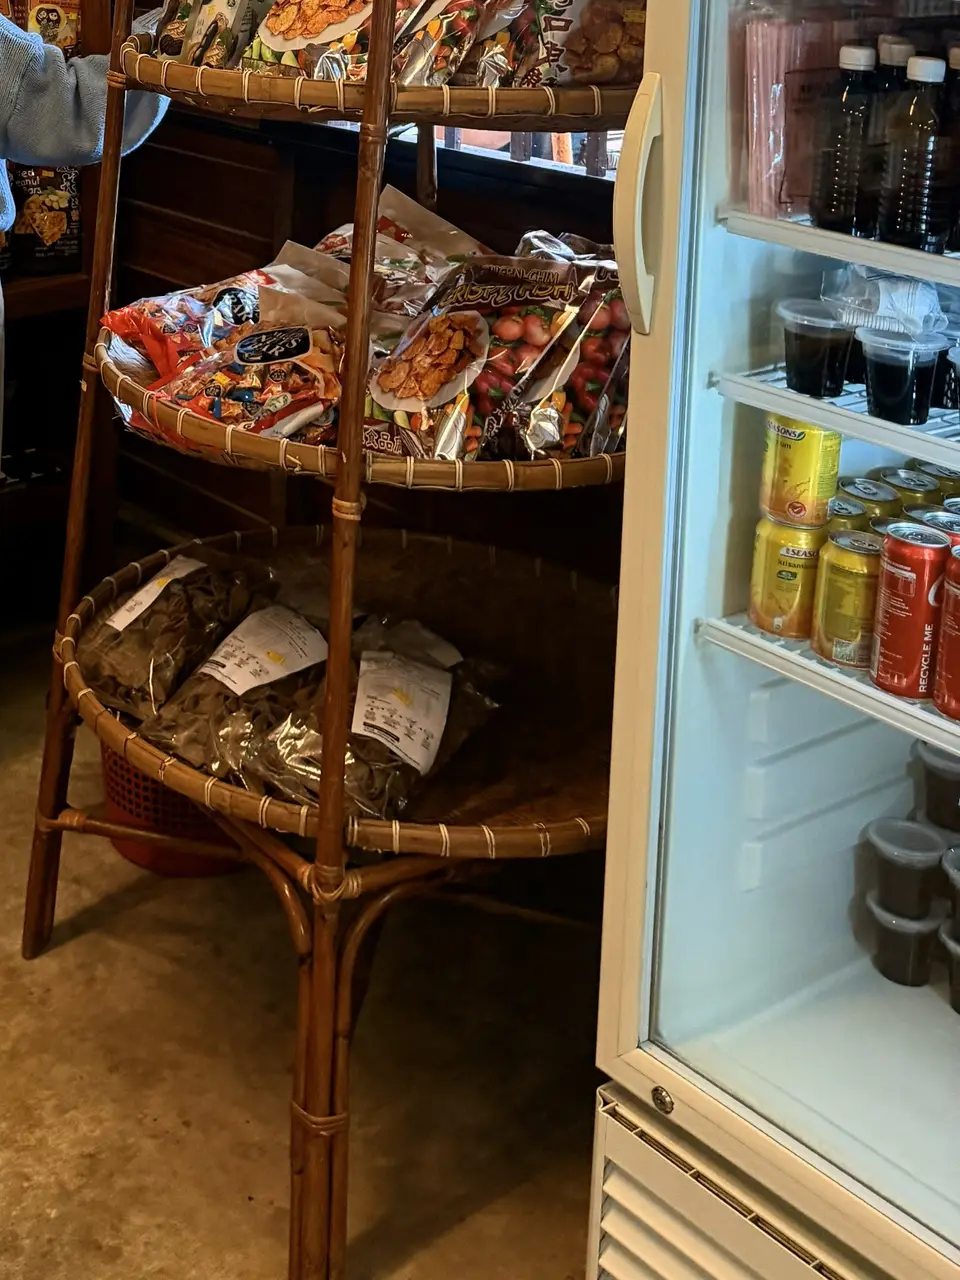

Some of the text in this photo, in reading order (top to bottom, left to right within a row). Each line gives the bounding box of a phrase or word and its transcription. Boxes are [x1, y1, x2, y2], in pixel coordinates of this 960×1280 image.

[791, 548, 818, 558] SEASO
[924, 623, 934, 641] ME
[919, 642, 932, 693] RECYCLE
